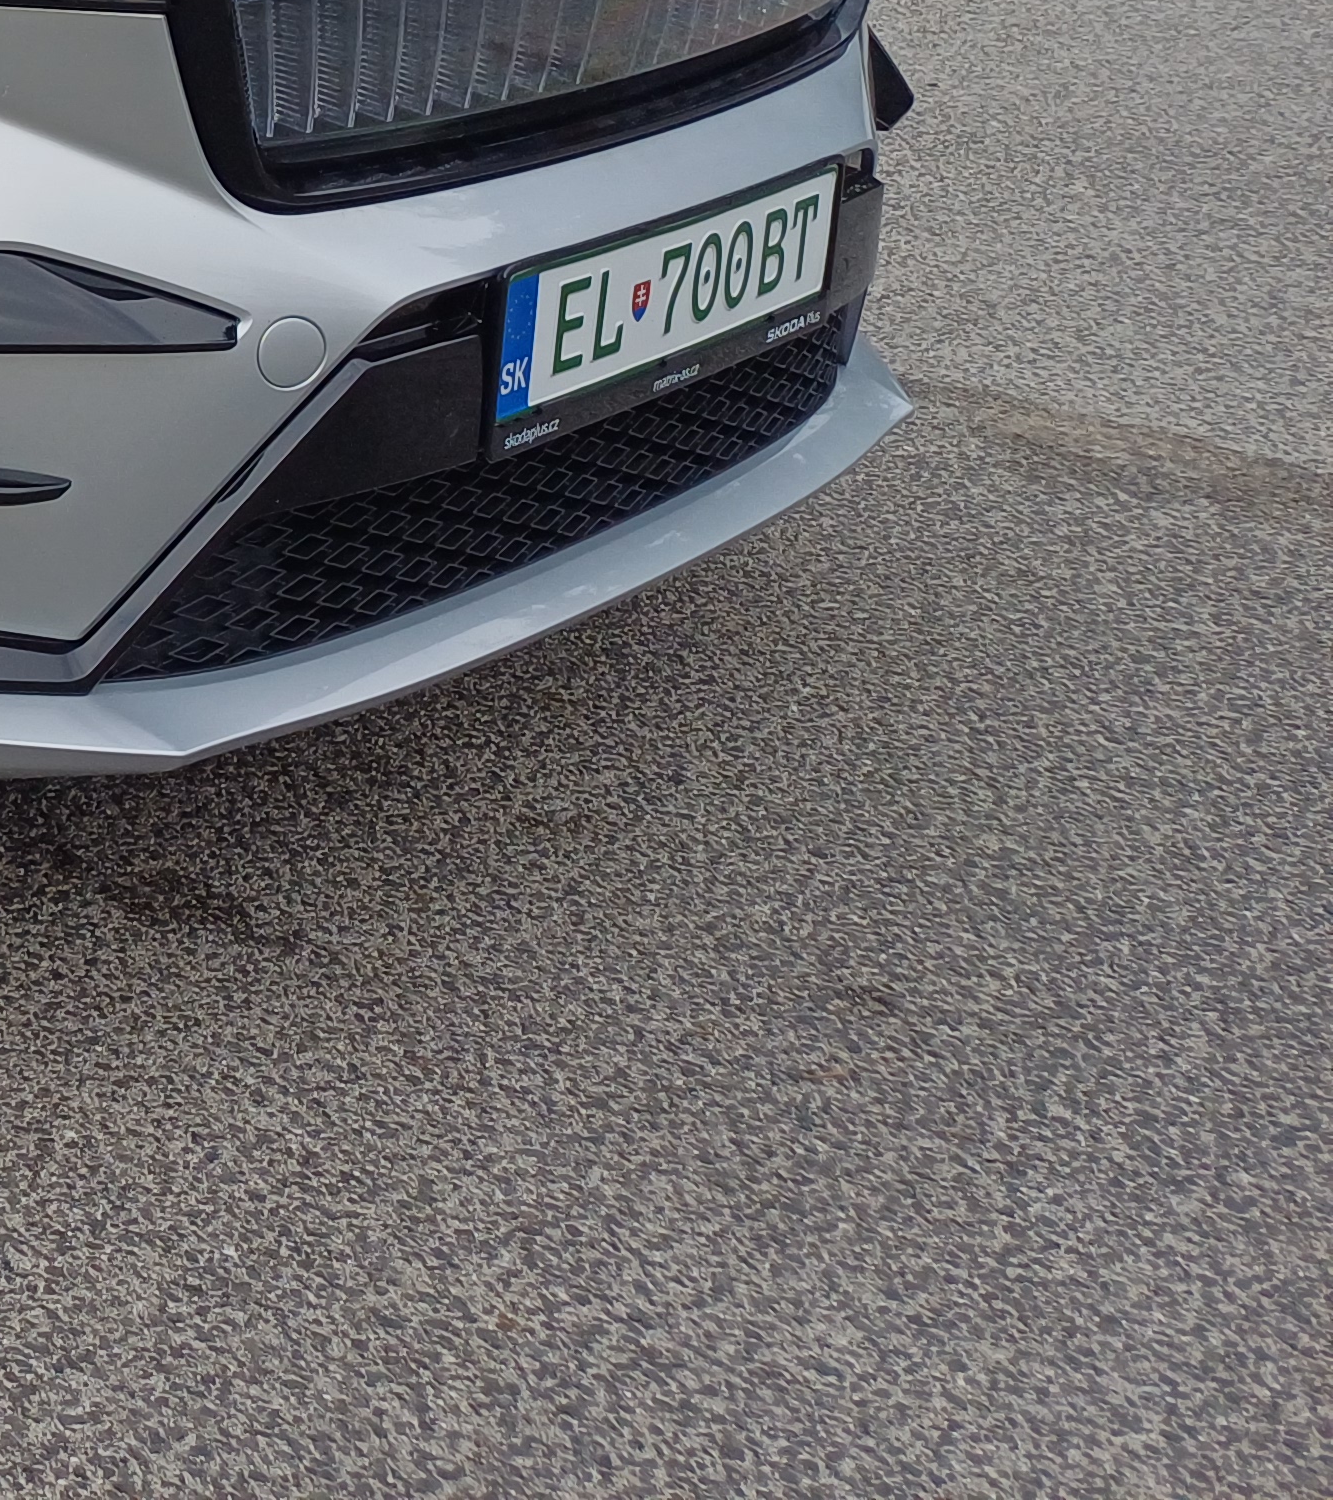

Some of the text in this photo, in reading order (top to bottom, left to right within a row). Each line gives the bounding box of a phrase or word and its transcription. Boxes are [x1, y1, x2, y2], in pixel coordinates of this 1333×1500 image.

[551, 192, 820, 376] EL 700BT
[499, 355, 530, 396] SK
